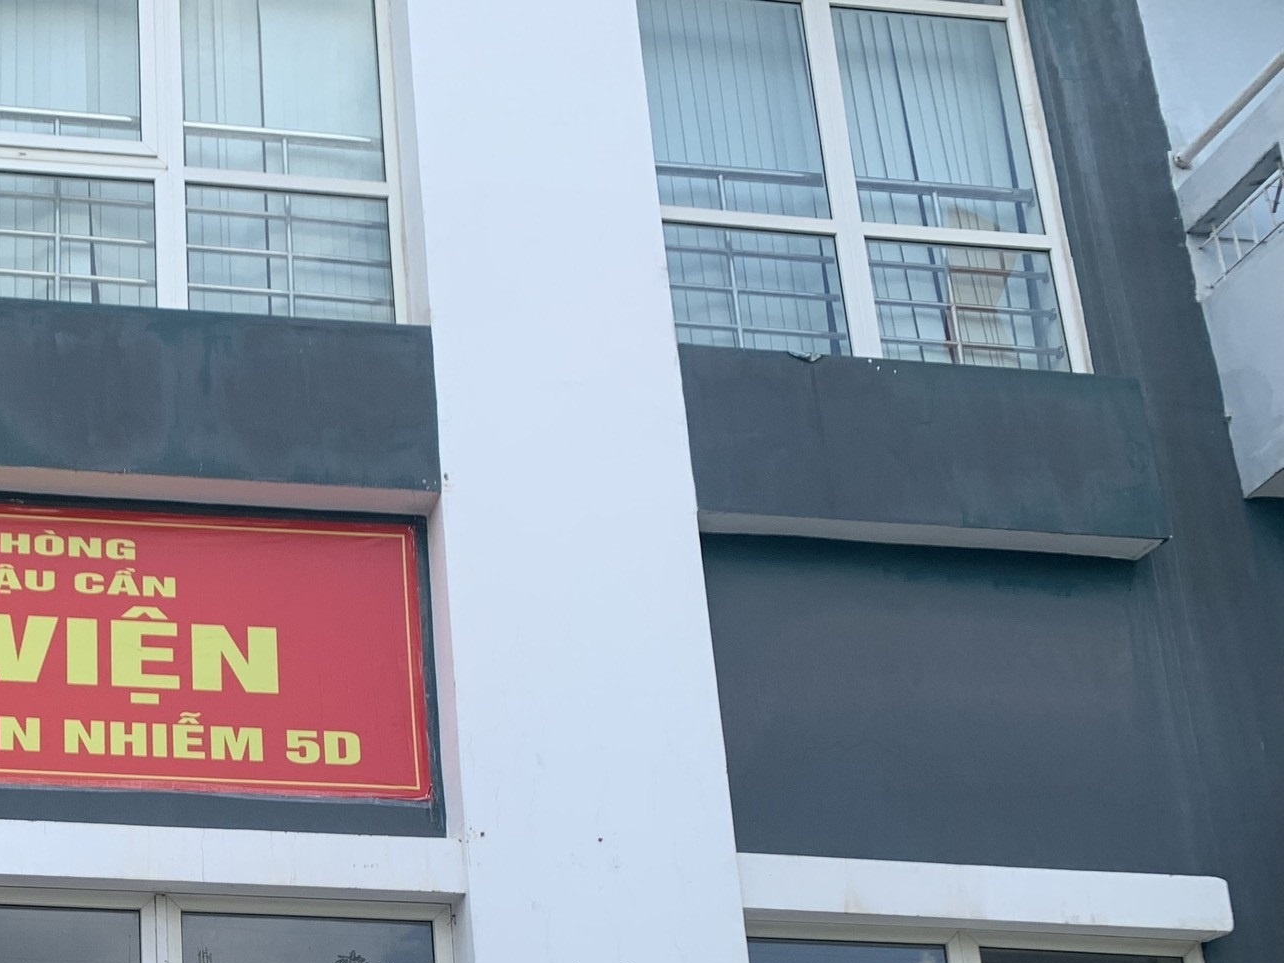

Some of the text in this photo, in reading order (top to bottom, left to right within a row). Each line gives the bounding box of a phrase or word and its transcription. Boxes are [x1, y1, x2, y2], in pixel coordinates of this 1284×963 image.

[74, 567, 177, 598] CẦN
[63, 711, 264, 762] NHIỄM
[285, 729, 362, 765] 5D
